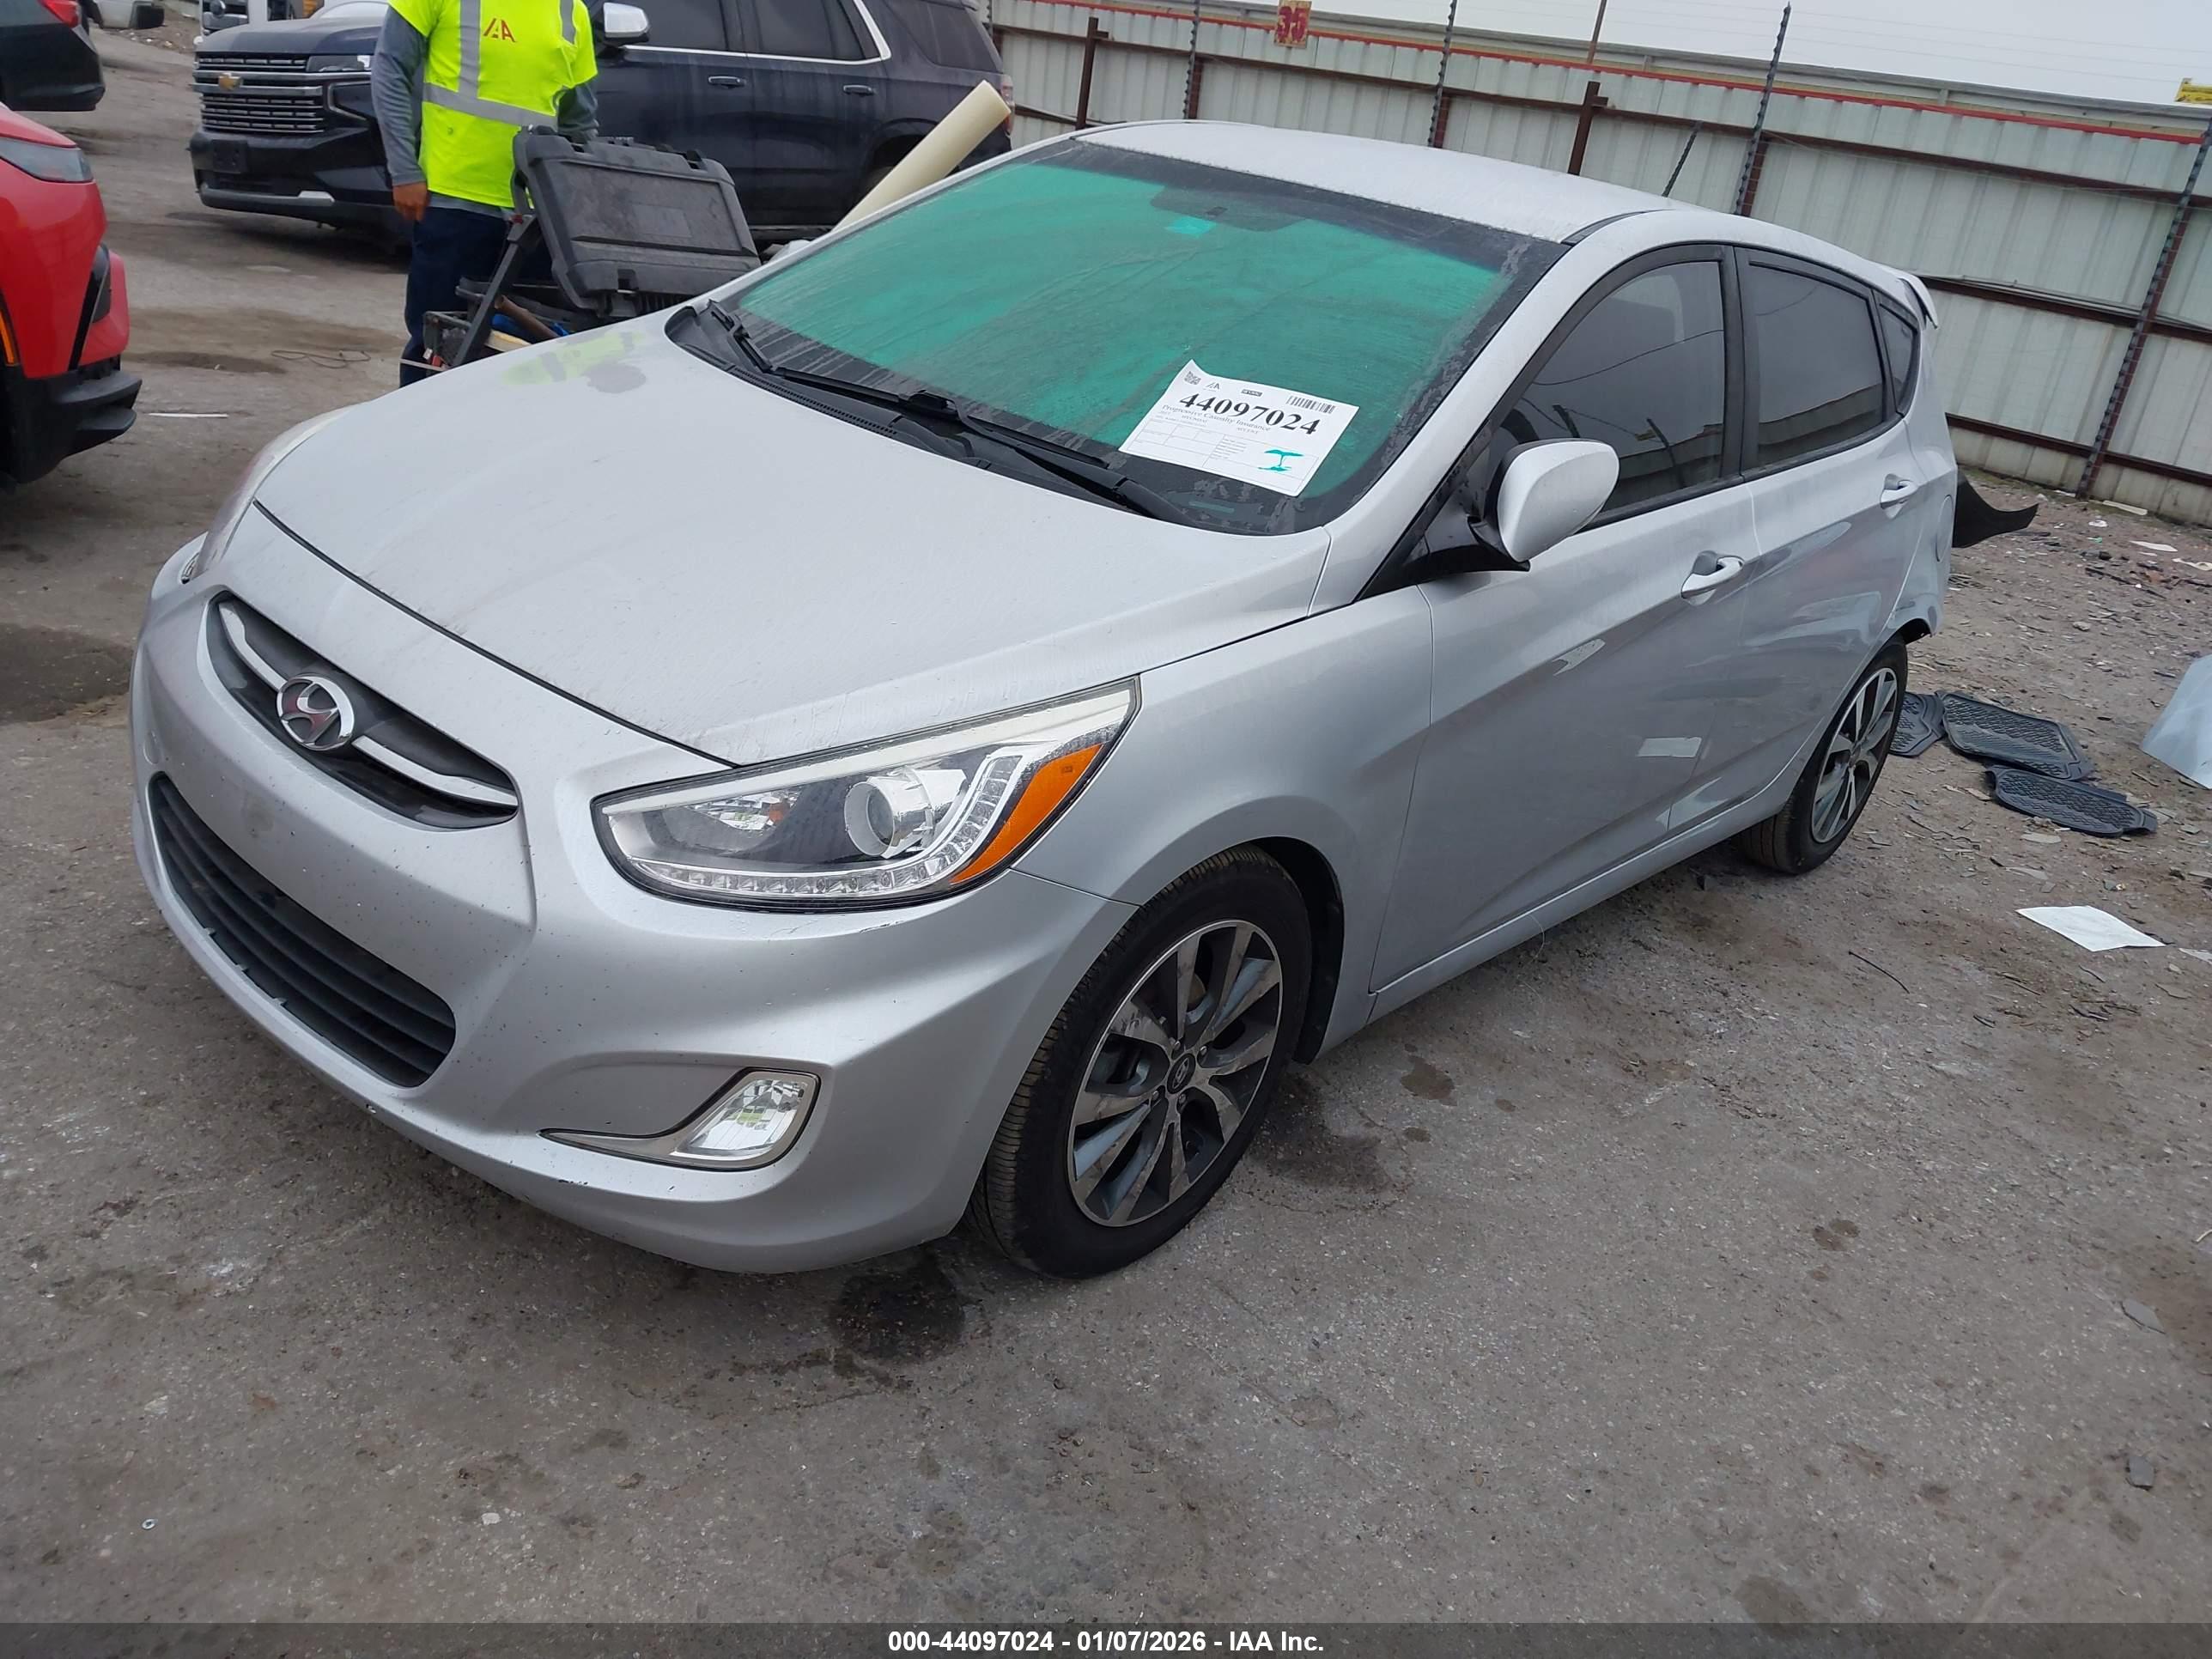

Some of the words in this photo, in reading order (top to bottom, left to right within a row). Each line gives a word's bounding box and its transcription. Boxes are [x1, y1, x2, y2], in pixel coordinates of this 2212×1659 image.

[1163, 404, 1203, 417] Progressive
[1204, 412, 1237, 425] Casualty
[1237, 419, 1271, 431] Insurance
[1180, 393, 1321, 434] 44097024
